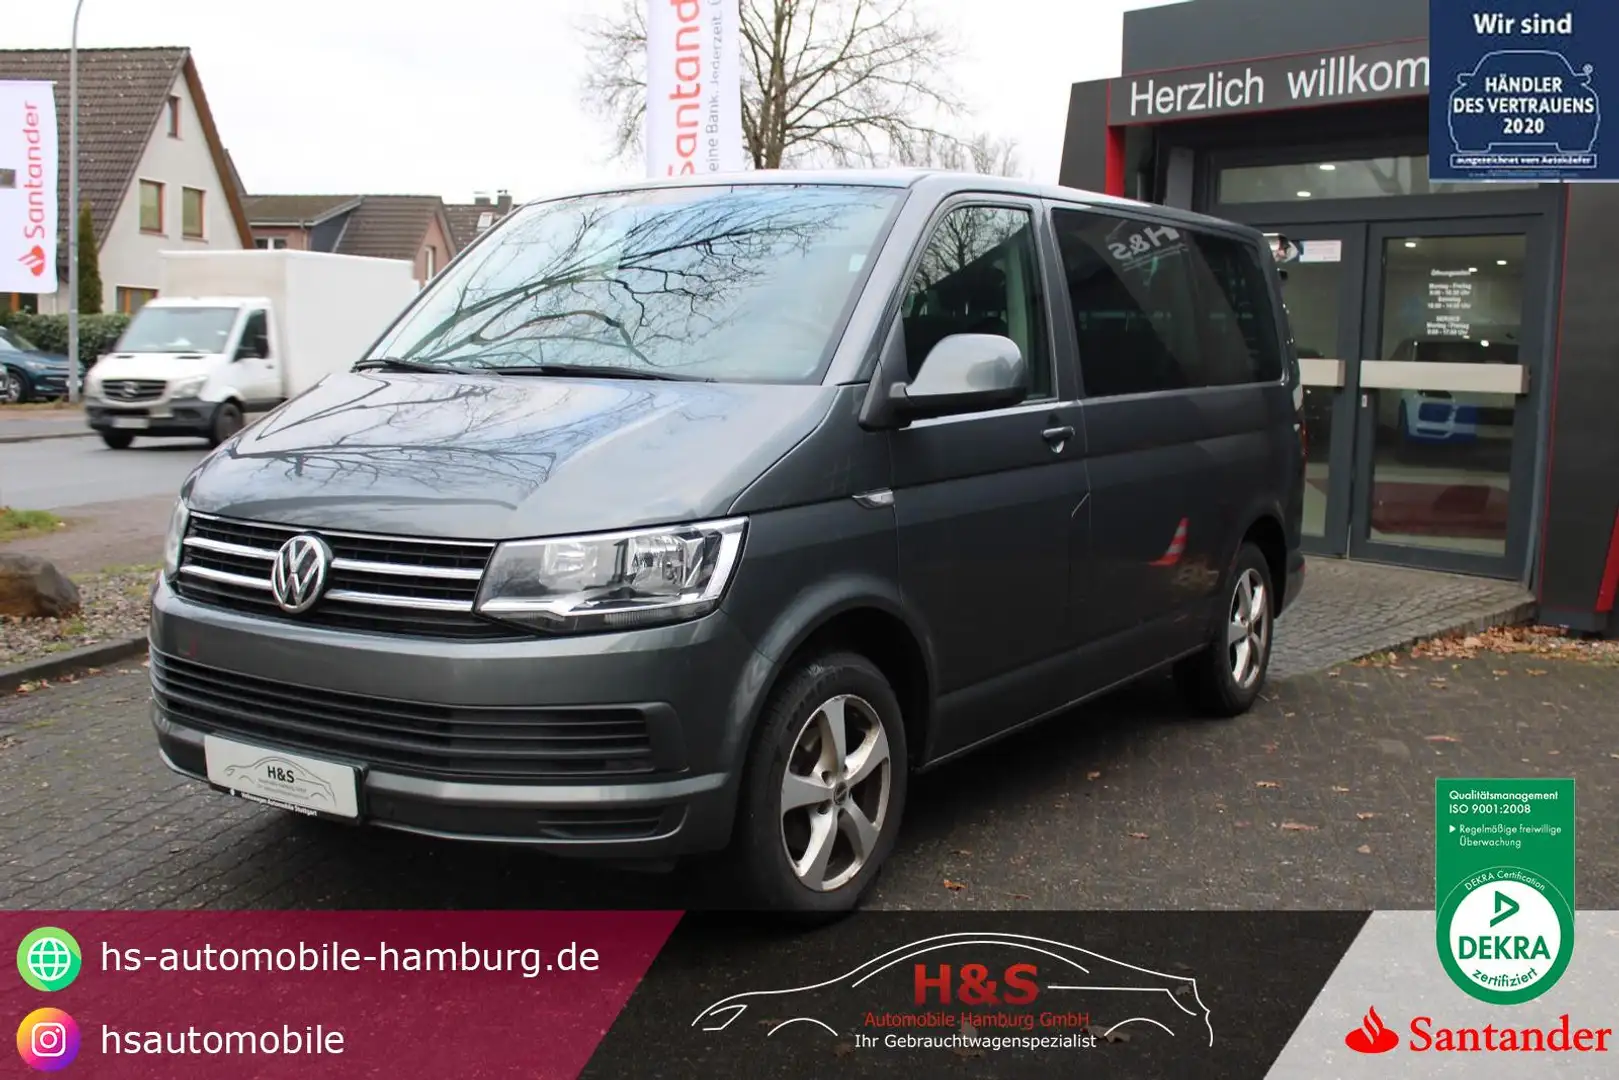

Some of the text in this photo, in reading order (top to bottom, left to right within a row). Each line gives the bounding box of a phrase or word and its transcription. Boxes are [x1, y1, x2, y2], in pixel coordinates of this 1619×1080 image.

[1130, 55, 1429, 117] Herzlich willkom
[22, 100, 45, 239] Santander
[267, 765, 295, 783] H&S
